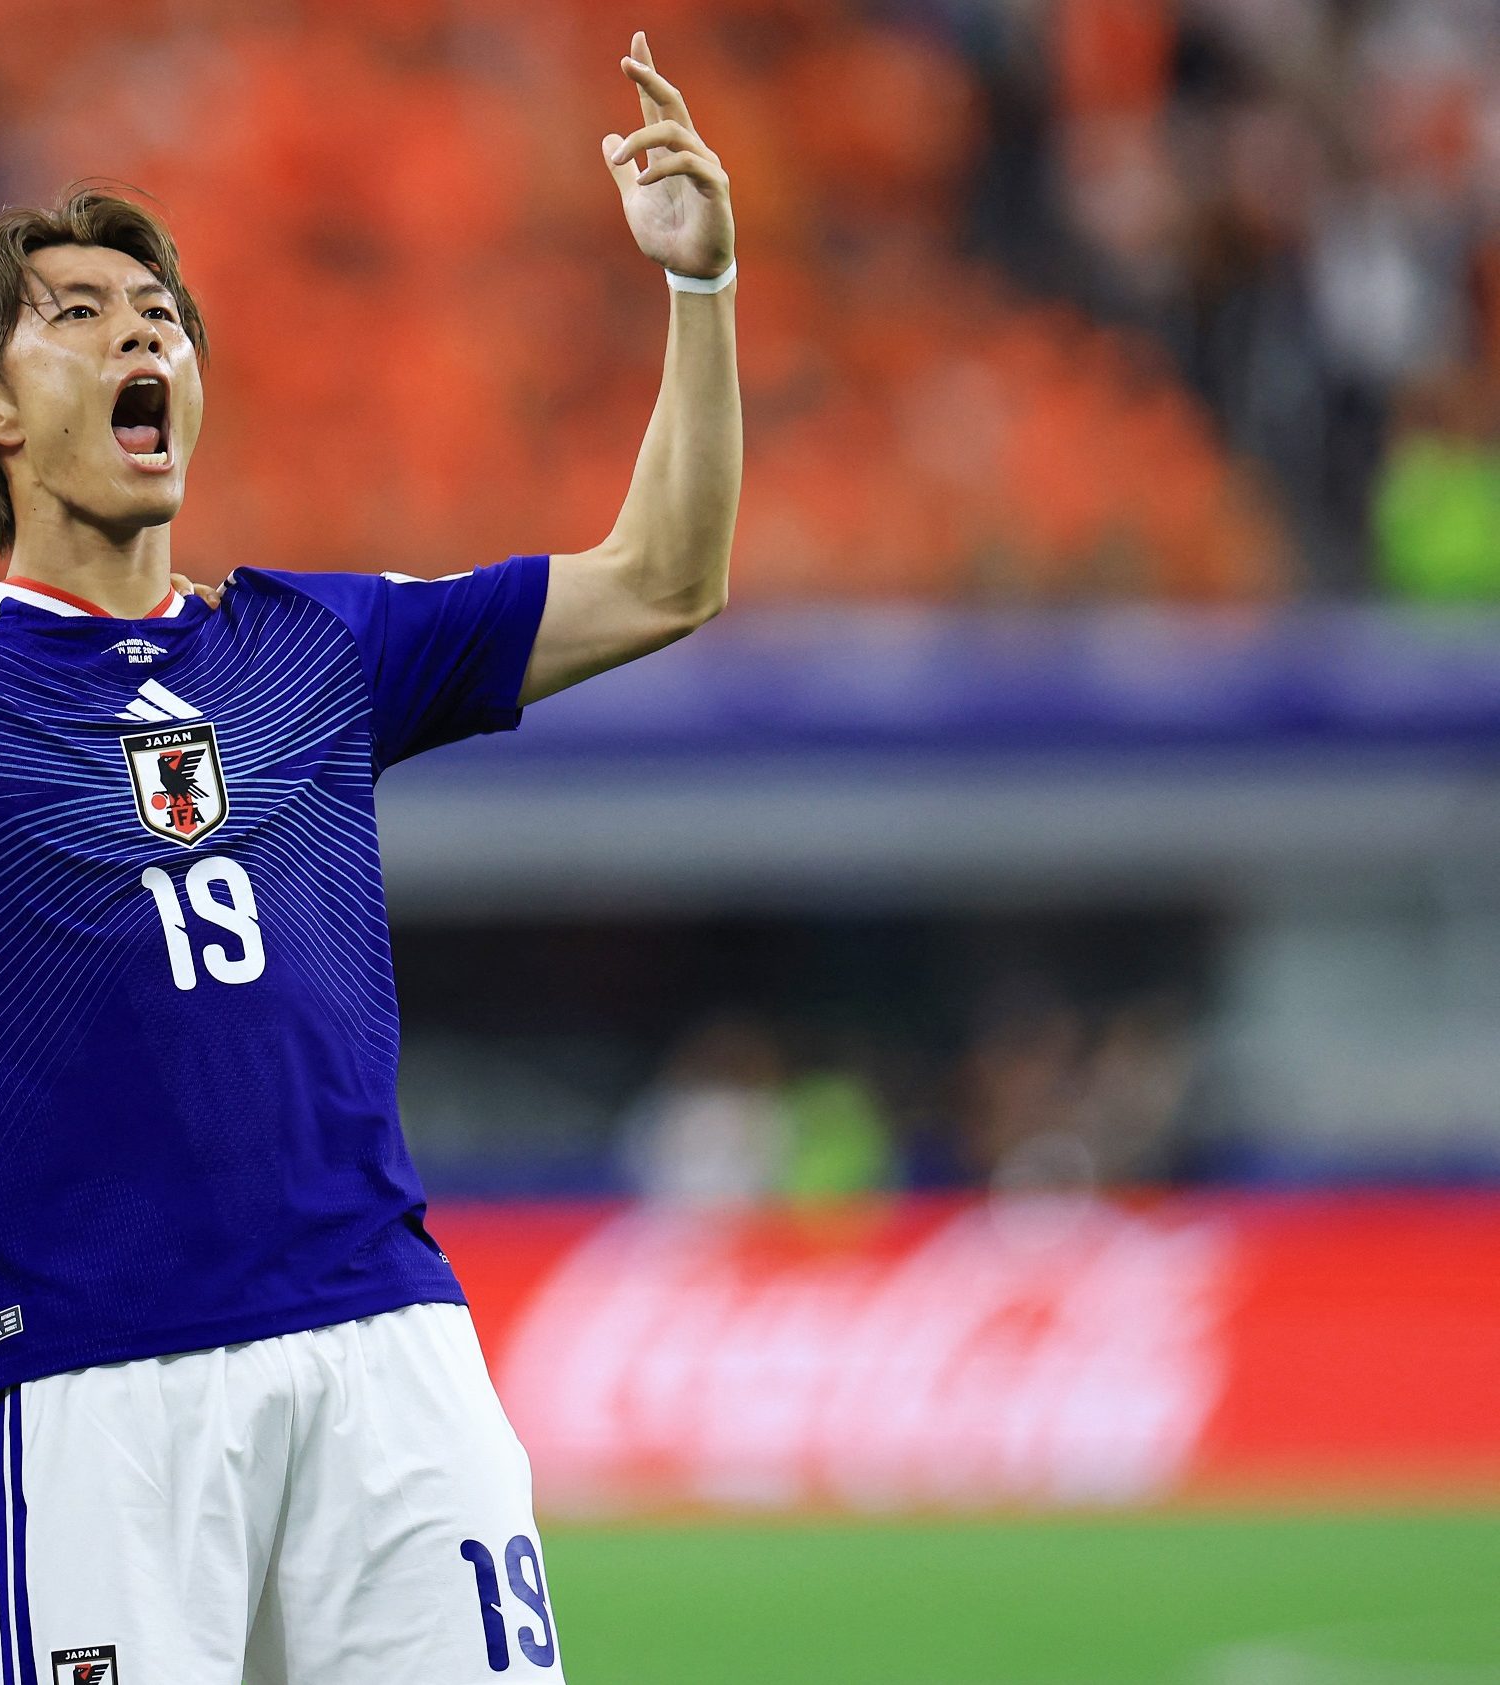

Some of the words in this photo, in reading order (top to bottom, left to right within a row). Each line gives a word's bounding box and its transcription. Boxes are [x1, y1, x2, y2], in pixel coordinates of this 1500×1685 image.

[128, 655, 153, 664] DALLAS
[145, 732, 192, 748] JAPAN
[165, 806, 206, 827] JFA
[141, 856, 266, 991] 19
[460, 1535, 555, 1671] 19
[65, 1649, 100, 1660] JAPAN
